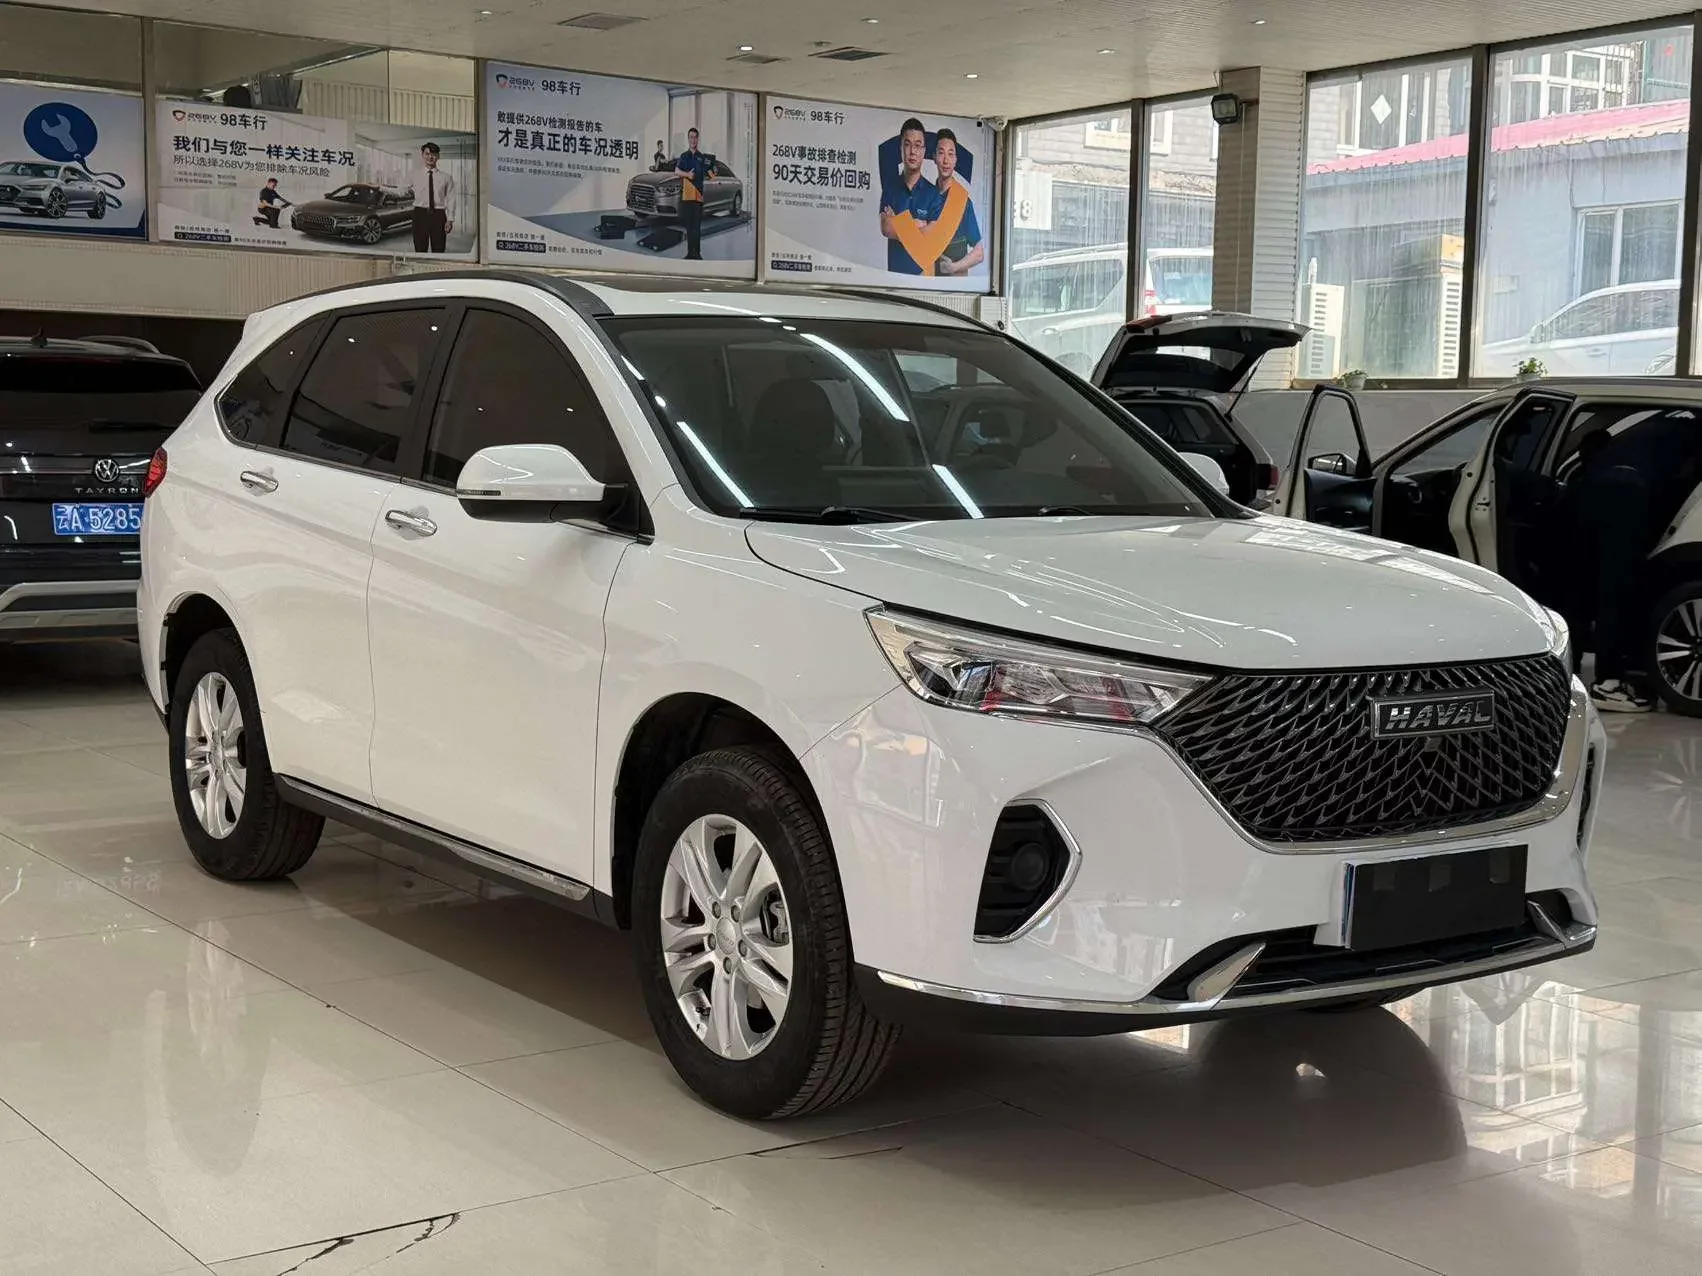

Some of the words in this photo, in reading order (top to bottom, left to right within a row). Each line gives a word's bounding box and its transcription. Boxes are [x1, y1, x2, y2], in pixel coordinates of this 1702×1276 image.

[541, 79, 582, 96] 98车行
[220, 112, 268, 131] 98车行
[497, 111, 603, 133] 敢提供268V检测报告的车
[810, 110, 845, 125] 98车行
[173, 135, 356, 167] 我们与您一样关注车况
[498, 127, 639, 160] 才是真正的车况透明
[772, 144, 857, 165] 268V事故排查检测
[173, 154, 330, 177] 所以选择268V为您排除车况风险
[772, 163, 871, 190] 90天交易价回购
[1385, 701, 1491, 729] HAVAL
